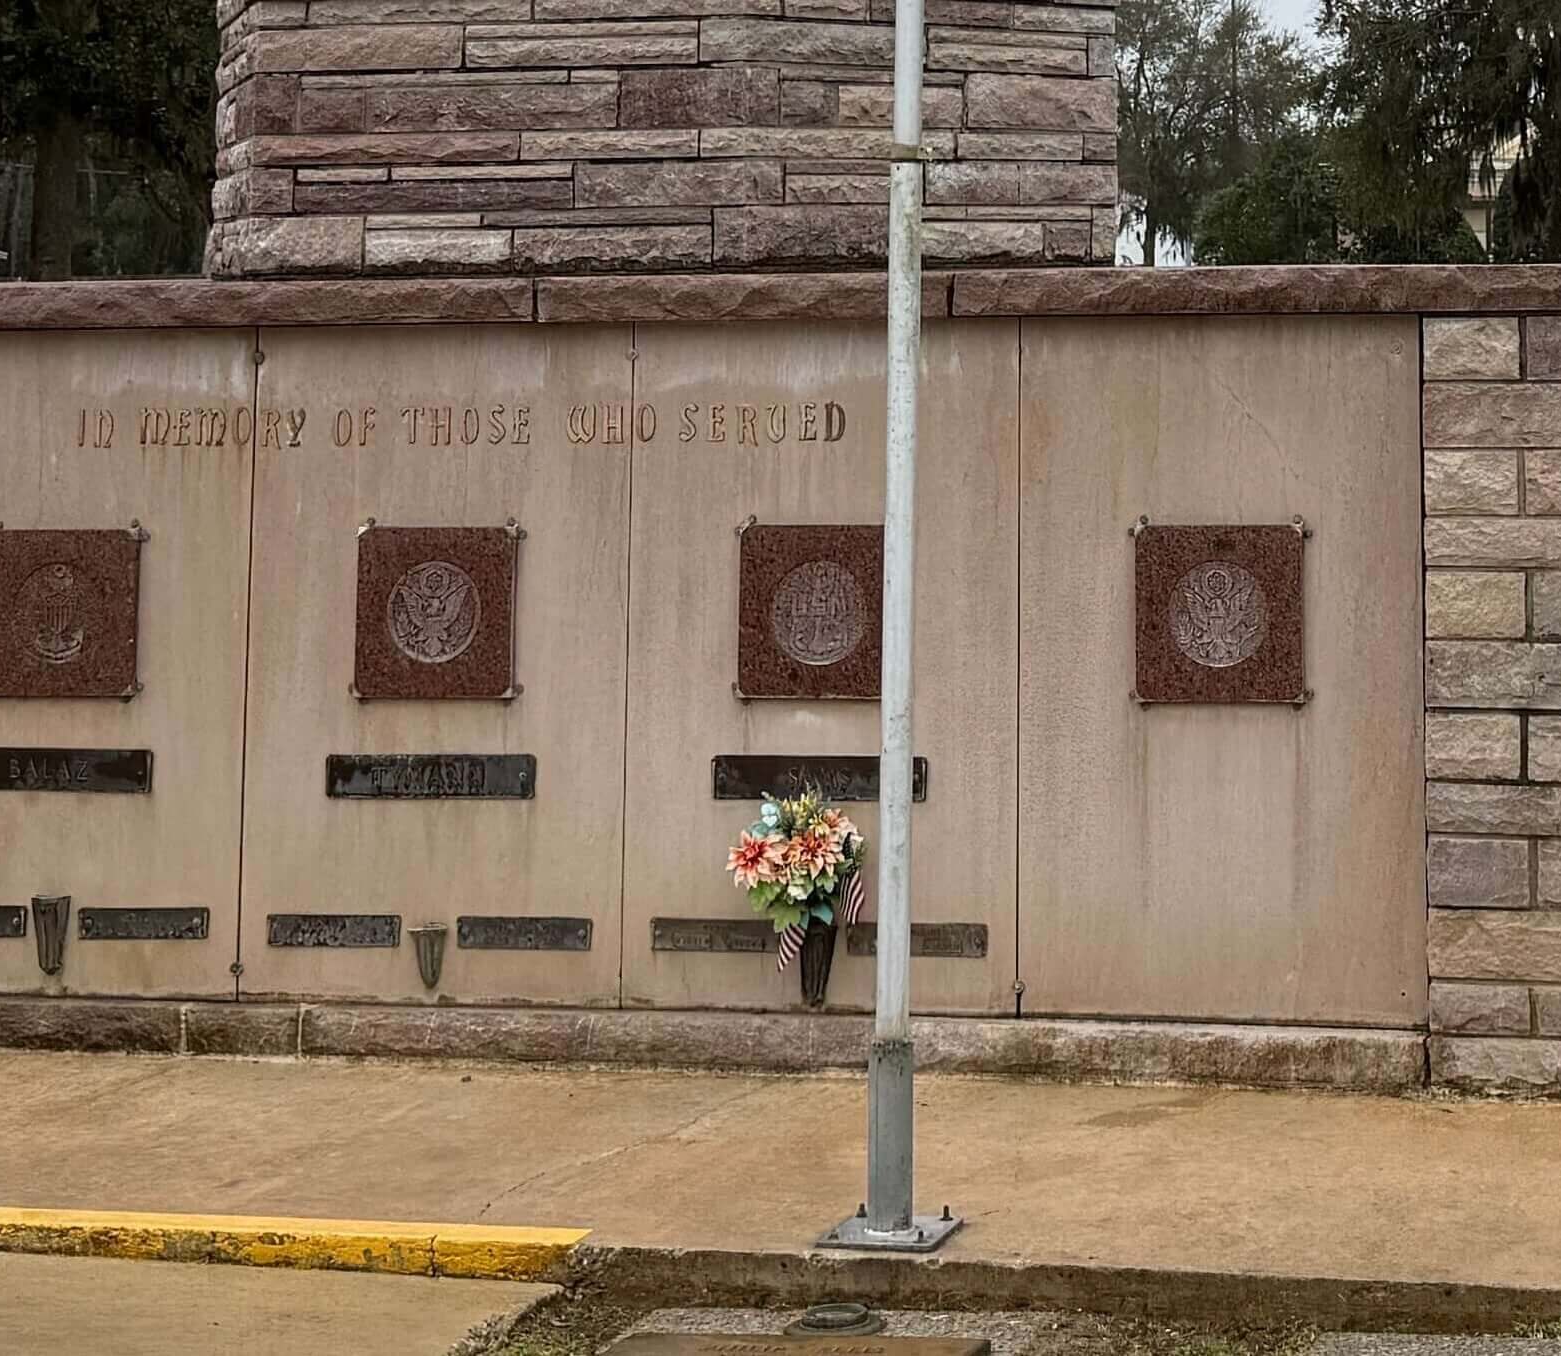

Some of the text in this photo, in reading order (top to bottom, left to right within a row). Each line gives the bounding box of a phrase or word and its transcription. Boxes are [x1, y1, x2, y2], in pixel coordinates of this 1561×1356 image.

[78, 407, 115, 449] IN
[140, 407, 307, 450] MEMORY
[333, 406, 376, 448] OF
[400, 404, 531, 446] THOSE
[566, 403, 657, 446] WHO
[8, 758, 89, 781] BALAZ
